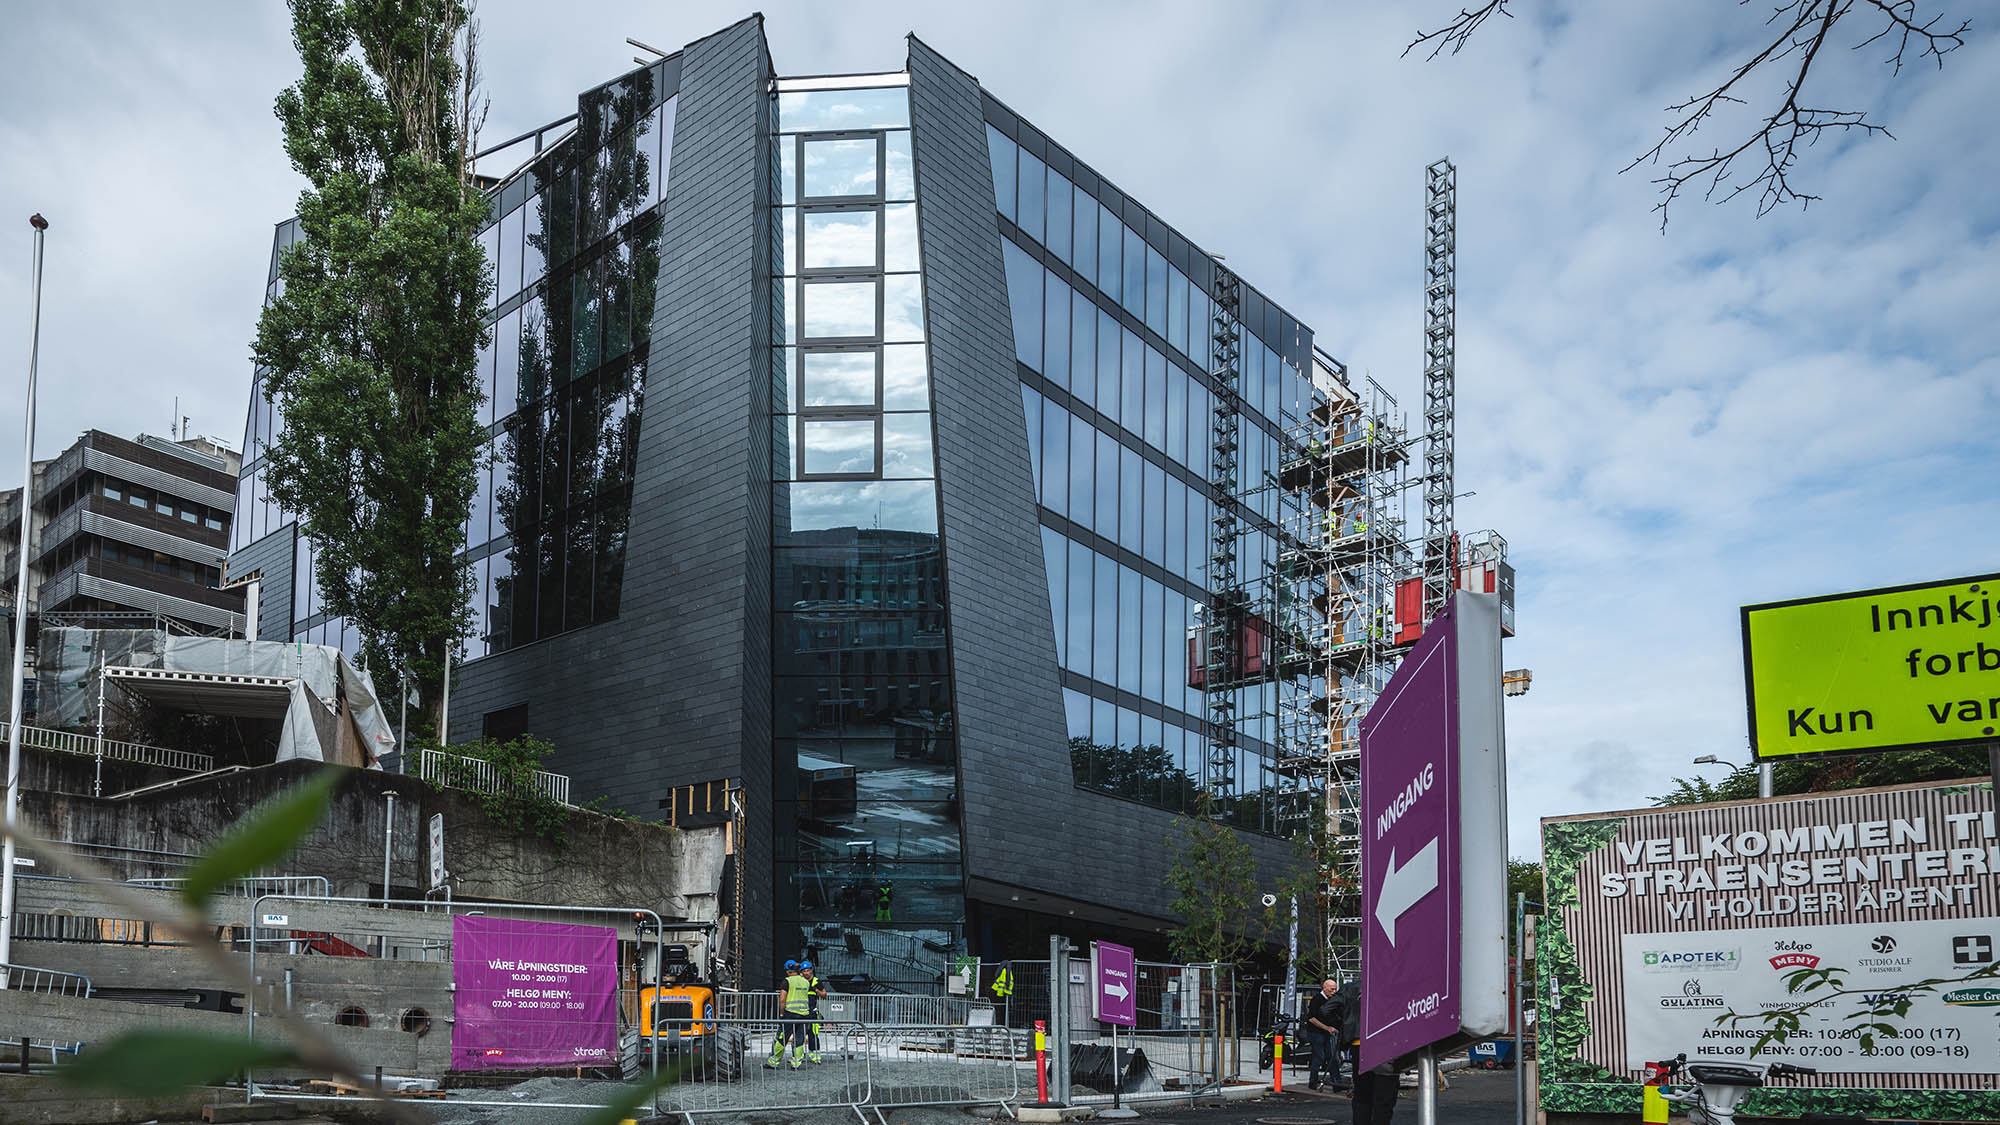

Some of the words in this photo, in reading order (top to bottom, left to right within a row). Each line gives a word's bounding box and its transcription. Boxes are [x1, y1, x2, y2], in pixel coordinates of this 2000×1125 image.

[1787, 707, 1873, 737] Kun
[1377, 762, 1433, 840] INNGANG
[1617, 816, 1928, 867] VELKOMMEN
[1666, 899, 1696, 920] VI
[1705, 891, 1845, 918] HOLDER
[1854, 882, 1979, 912] ÅPENT
[1661, 951, 1726, 963] APOTEK
[1728, 951, 1737, 961] 1
[1774, 954, 1816, 968] MENY
[1858, 957, 1893, 967] STUDIO
[1895, 957, 1913, 966] ALF
[489, 959, 514, 970] VÅRE
[517, 960, 588, 974] ÅPNINGSTIDER:
[512, 973, 530, 982] 10.00
[536, 974, 556, 982] 20.00
[557, 975, 567, 983] (17)
[1105, 968, 1128, 979] INNGANG
[507, 988, 540, 998] HELGØ
[543, 990, 571, 1000] MENY:
[518, 1001, 538, 1009] 20.00
[1406, 992, 1439, 1021] Straen
[1660, 998, 1724, 1007] GULATING
[1759, 1000, 1837, 1009] VINMONOPOLET
[1818, 1028, 1861, 1040] 10:00
[1930, 1028, 1960, 1041] (17)
[574, 1047, 606, 1056] Straen
[1697, 1046, 1745, 1055] HELGØ
[1800, 1046, 1843, 1056] 07:00
[1910, 1045, 1969, 1058] (09-18)
